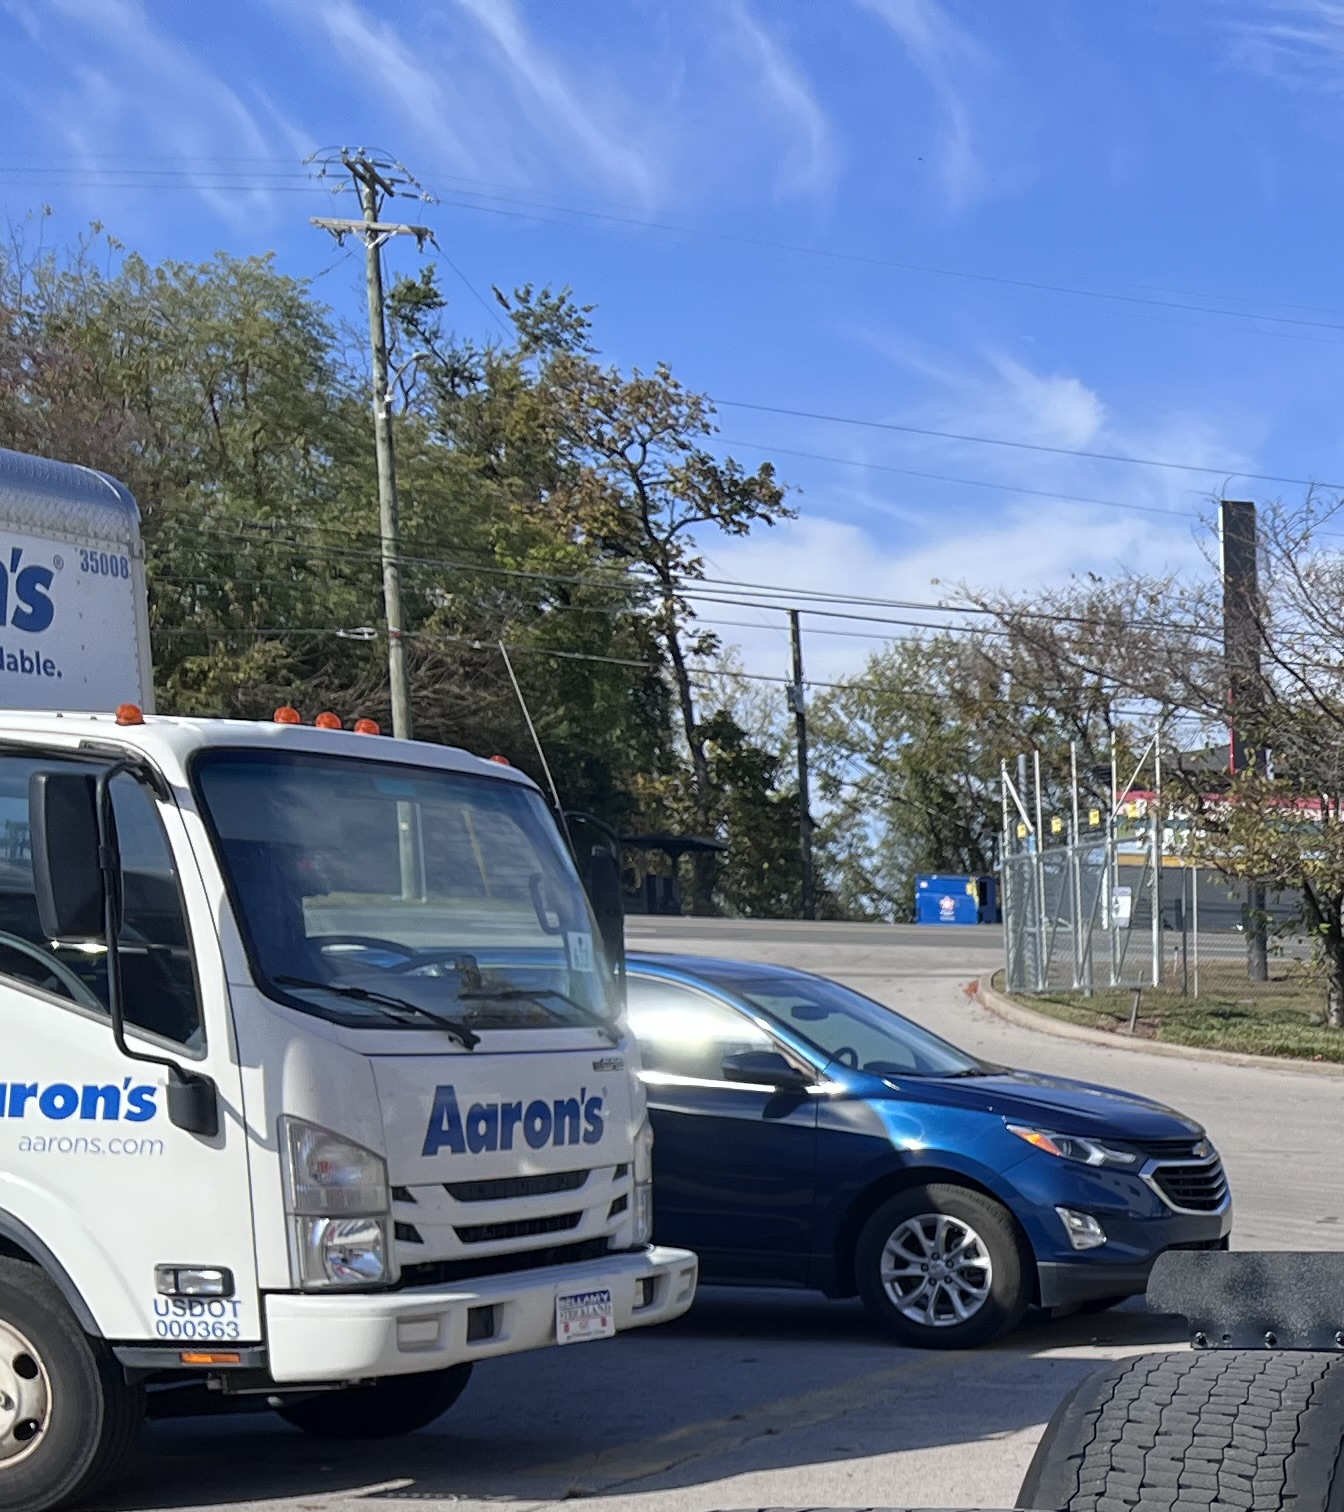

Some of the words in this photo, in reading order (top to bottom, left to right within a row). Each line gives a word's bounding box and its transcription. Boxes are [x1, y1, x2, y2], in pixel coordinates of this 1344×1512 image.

[79, 548, 129, 579] 35008
[0, 546, 54, 633] 's
[0, 1077, 157, 1122] ron's
[421, 1084, 605, 1157] Aaron's
[18, 1135, 164, 1156] aarons.com
[153, 1298, 241, 1318] USDOT
[156, 1320, 240, 1338] 000363
